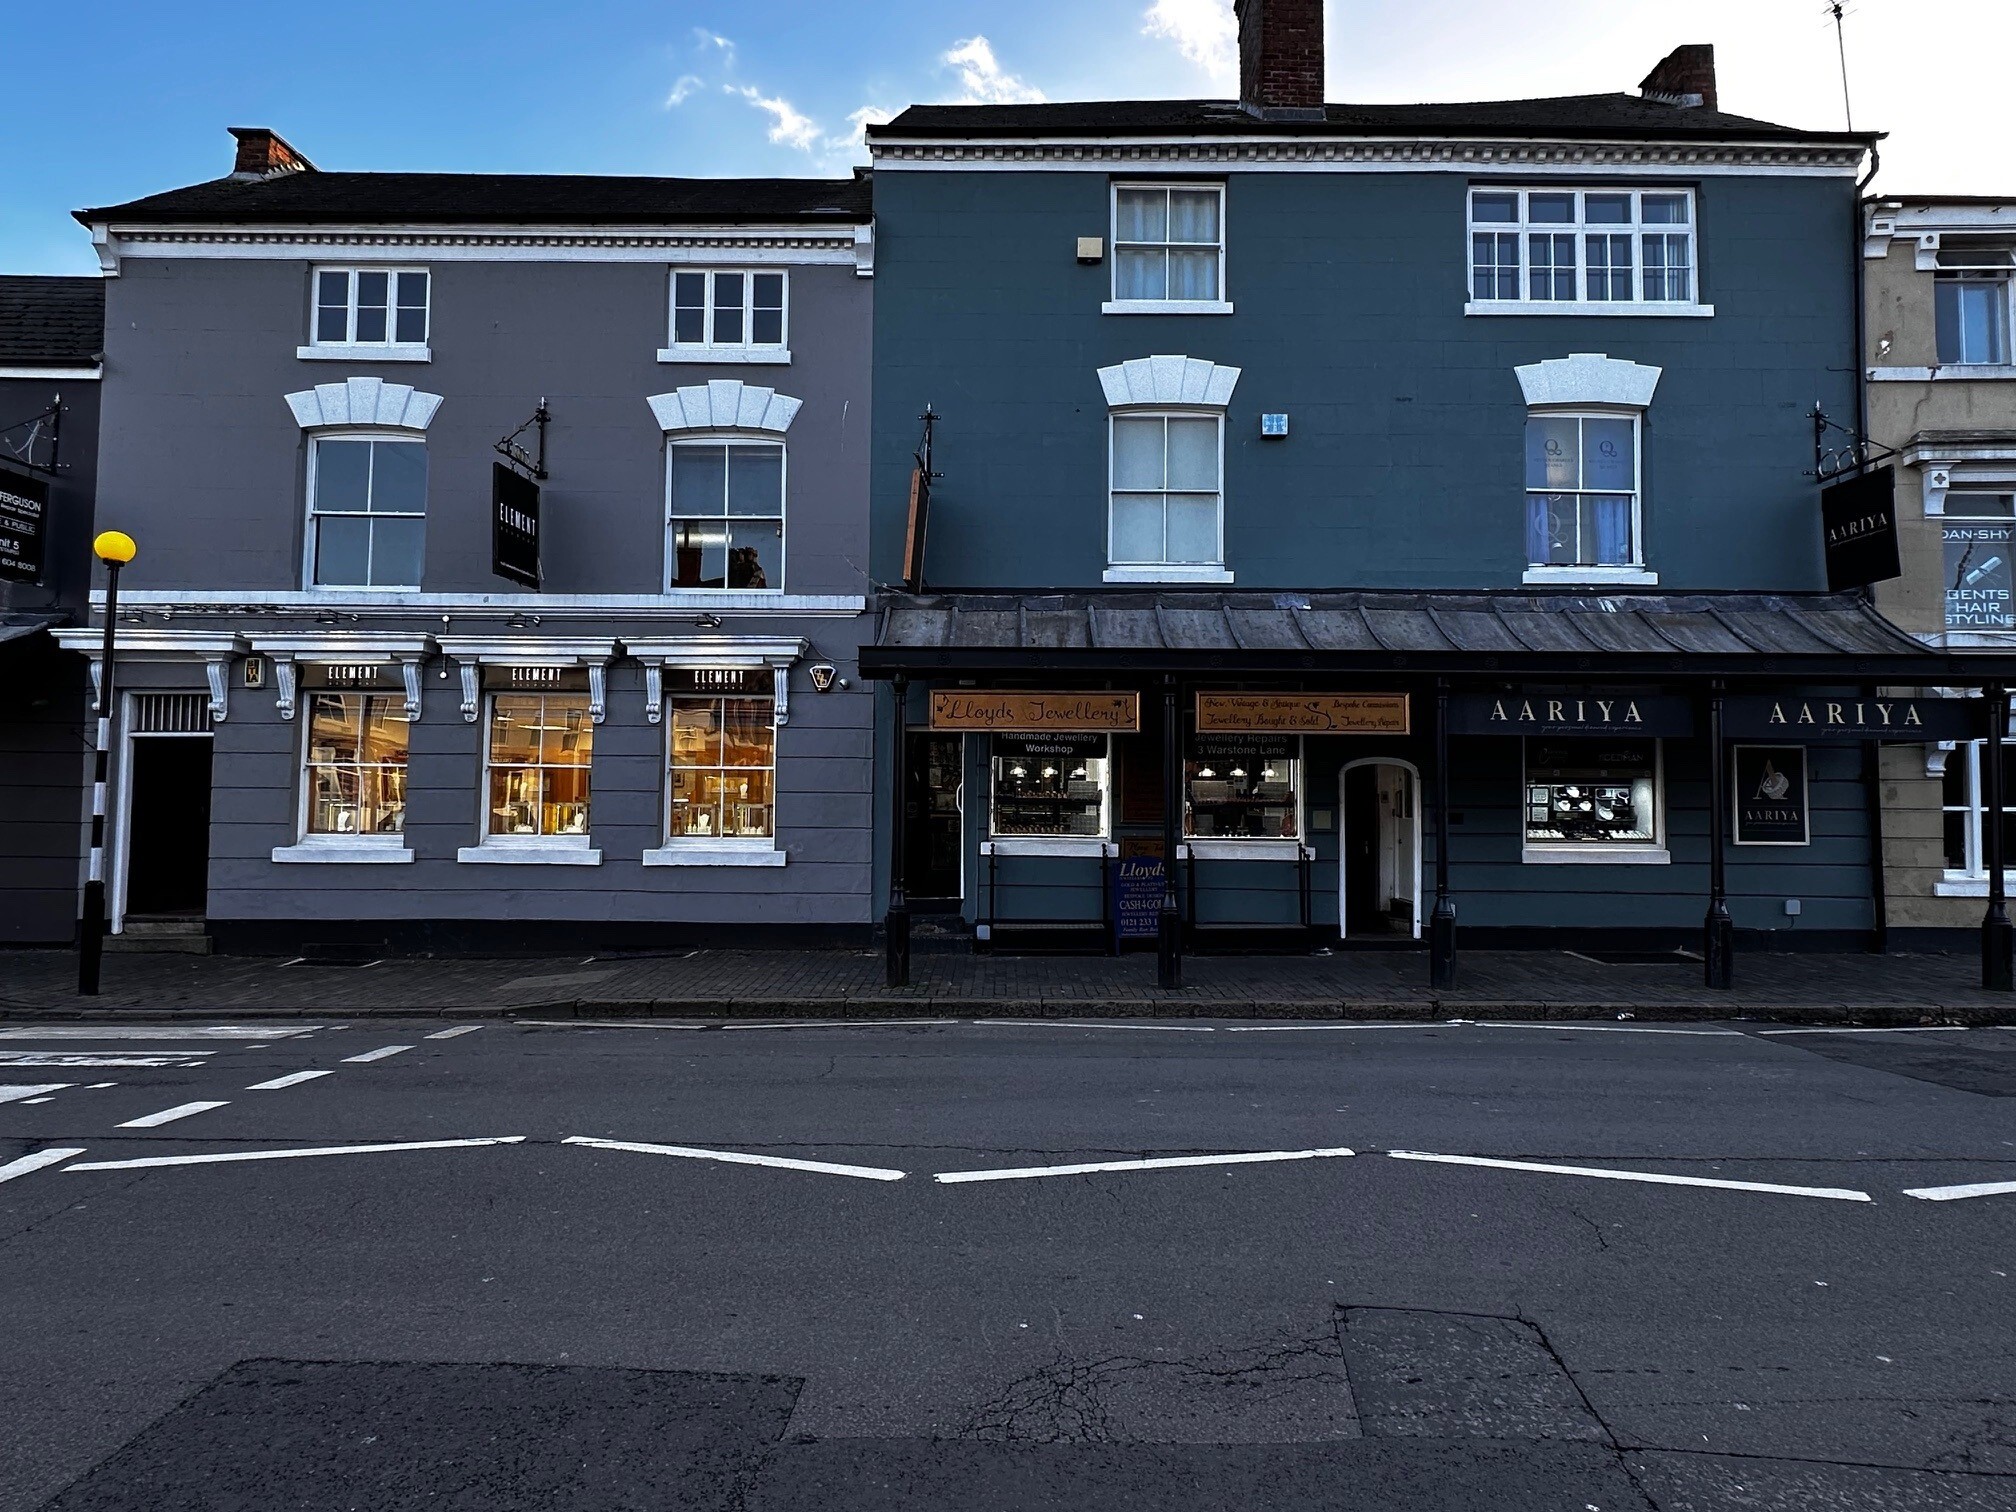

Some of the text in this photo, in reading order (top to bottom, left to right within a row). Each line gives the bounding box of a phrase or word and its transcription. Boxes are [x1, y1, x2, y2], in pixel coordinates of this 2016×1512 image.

[0, 490, 41, 512] FERGUSON
[500, 503, 535, 536] ELEMENT
[11, 521, 36, 533] PUBLIC
[1829, 512, 1887, 542] AARIYA
[13, 540, 20, 550] 5
[1947, 589, 2010, 600] GENTS
[1956, 602, 2001, 613] HAIR
[328, 666, 378, 679] ELEMENT
[512, 668, 561, 681] ELEMENT
[694, 670, 744, 684] ELEMENT
[947, 699, 1119, 726] Lloyds Jewellery
[1490, 699, 1643, 723] AARIYA
[1769, 702, 1923, 726] AARIYA
[1204, 713, 1252, 727] Jewellery
[1254, 713, 1286, 728] Bought
[1054, 734, 1097, 743] Jewellery
[1194, 734, 1288, 744] Jewellery Repairs
[1025, 744, 1073, 754] Workshop
[1197, 746, 1285, 754] 3 Warstone Lane
[1745, 810, 1798, 820] AARIYA
